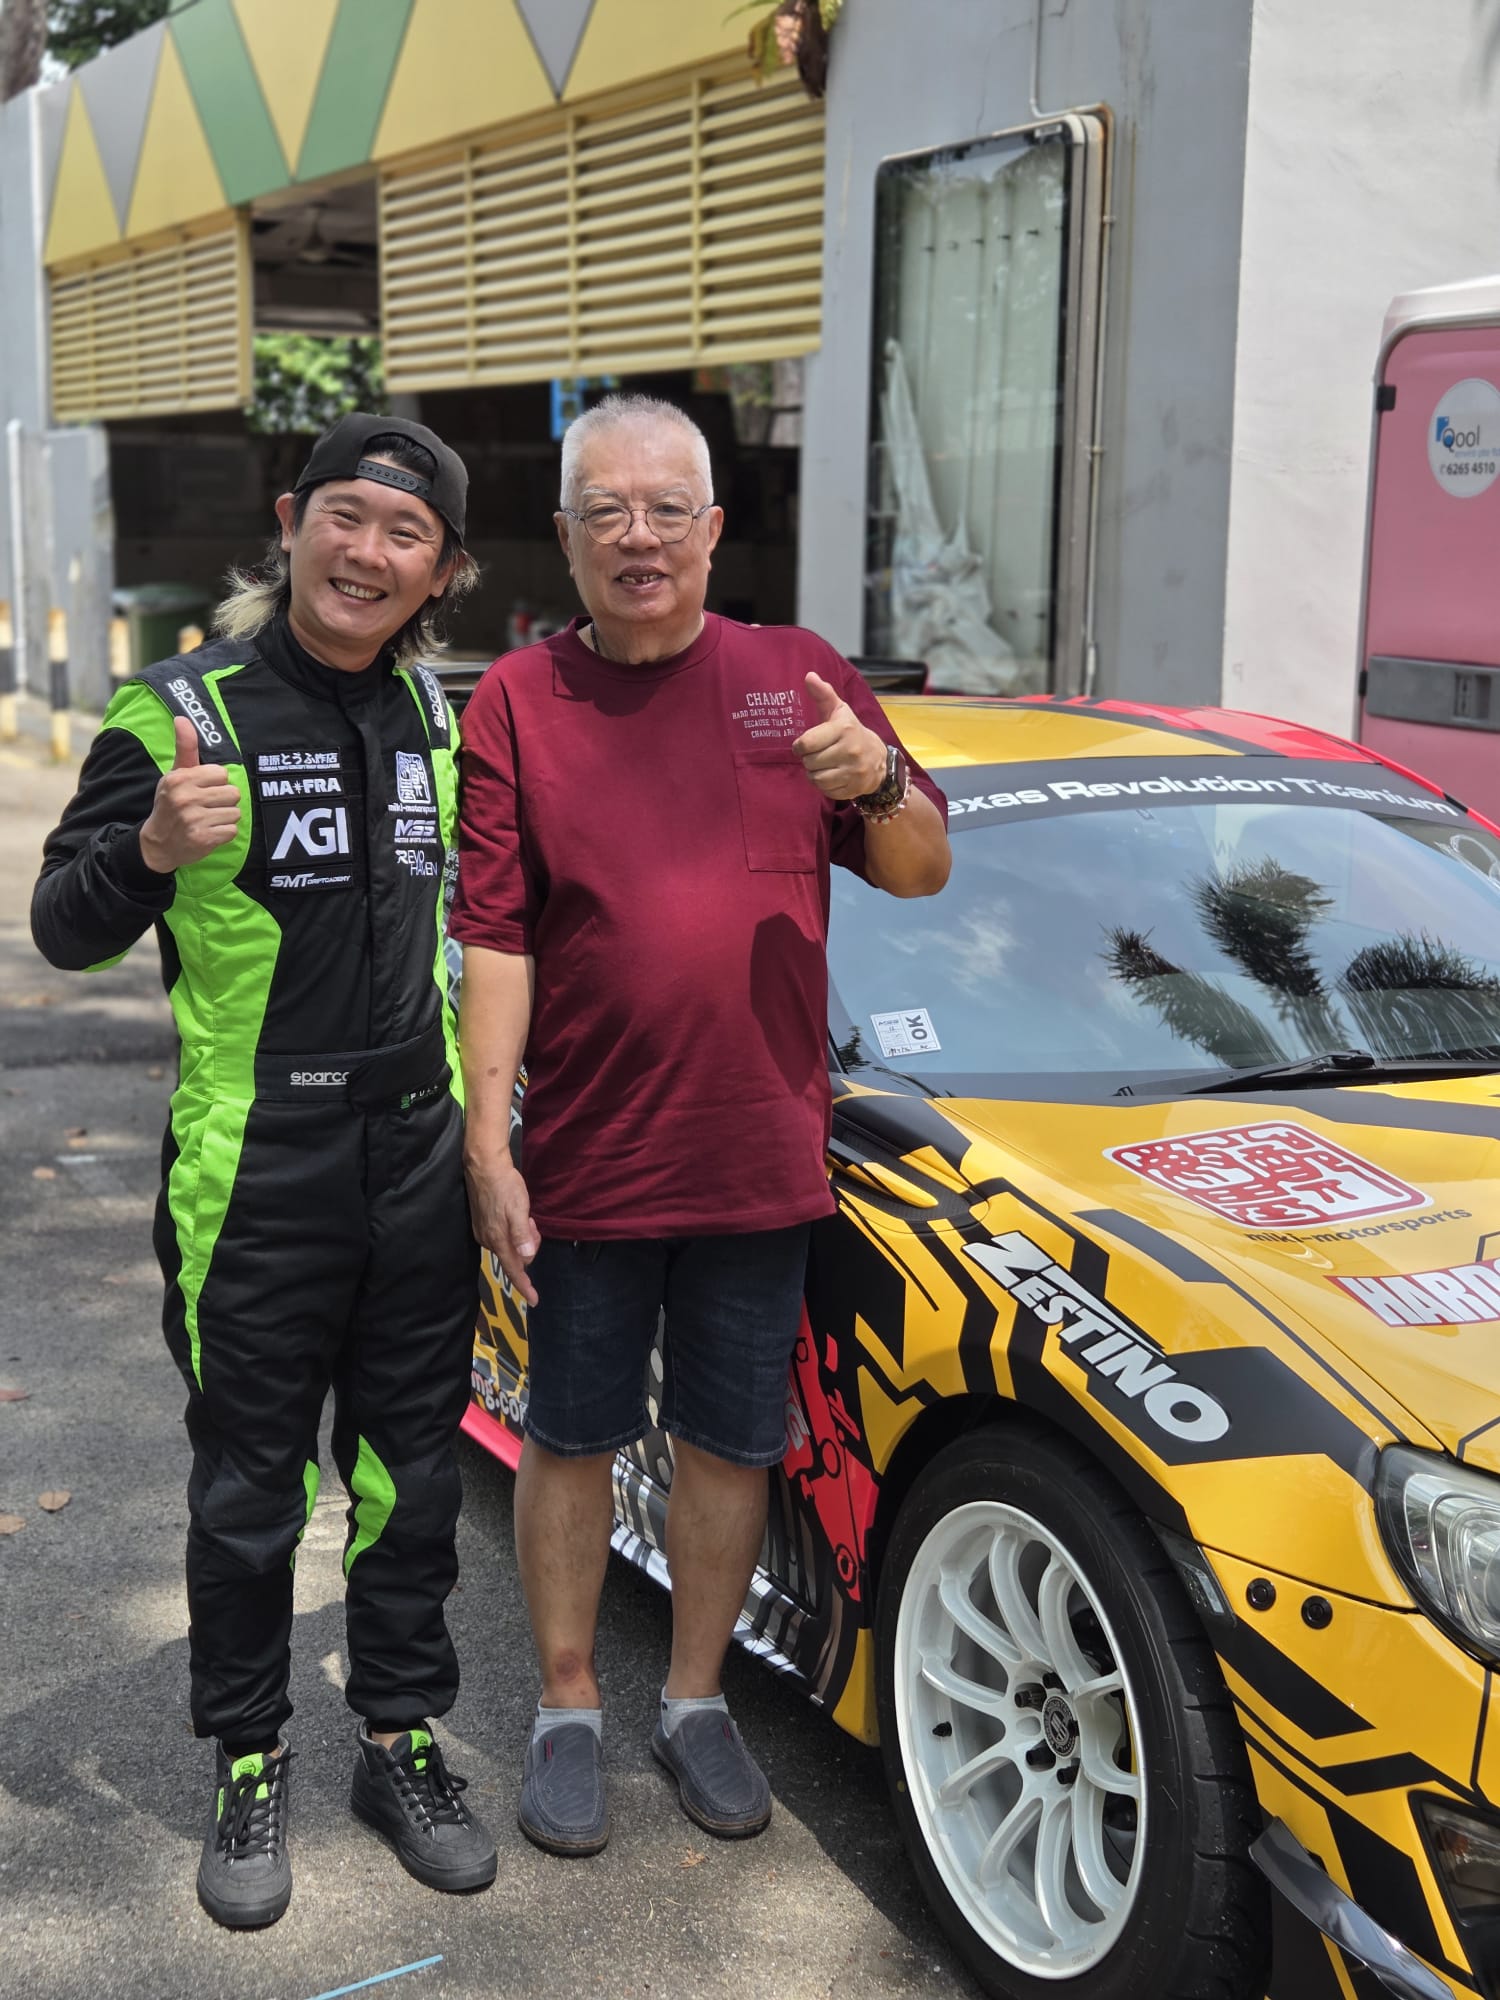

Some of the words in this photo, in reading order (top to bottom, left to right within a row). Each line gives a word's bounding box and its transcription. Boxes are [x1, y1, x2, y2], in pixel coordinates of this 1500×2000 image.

[1442, 424, 1481, 453] Qool
[1447, 463, 1470, 475] 6265
[1471, 462, 1495, 474] 4510
[168, 679, 222, 746] sparco
[416, 666, 447, 730] sparco
[732, 710, 749, 720] HARD
[750, 708, 766, 717] DAYS
[768, 707, 778, 716] ARE
[746, 689, 801, 706] CHAMPI
[744, 718, 770, 728] BECAUSE
[1047, 775, 1291, 800] Revolution
[1283, 777, 1459, 817] Titanium
[271, 807, 350, 860] AGI
[270, 873, 316, 888] SMT
[905, 1015, 928, 1041] OK
[1245, 1207, 1473, 1243] miki-motorsports
[1336, 1258, 1500, 1325] HARD
[961, 1230, 1230, 1443] ZESTINO
